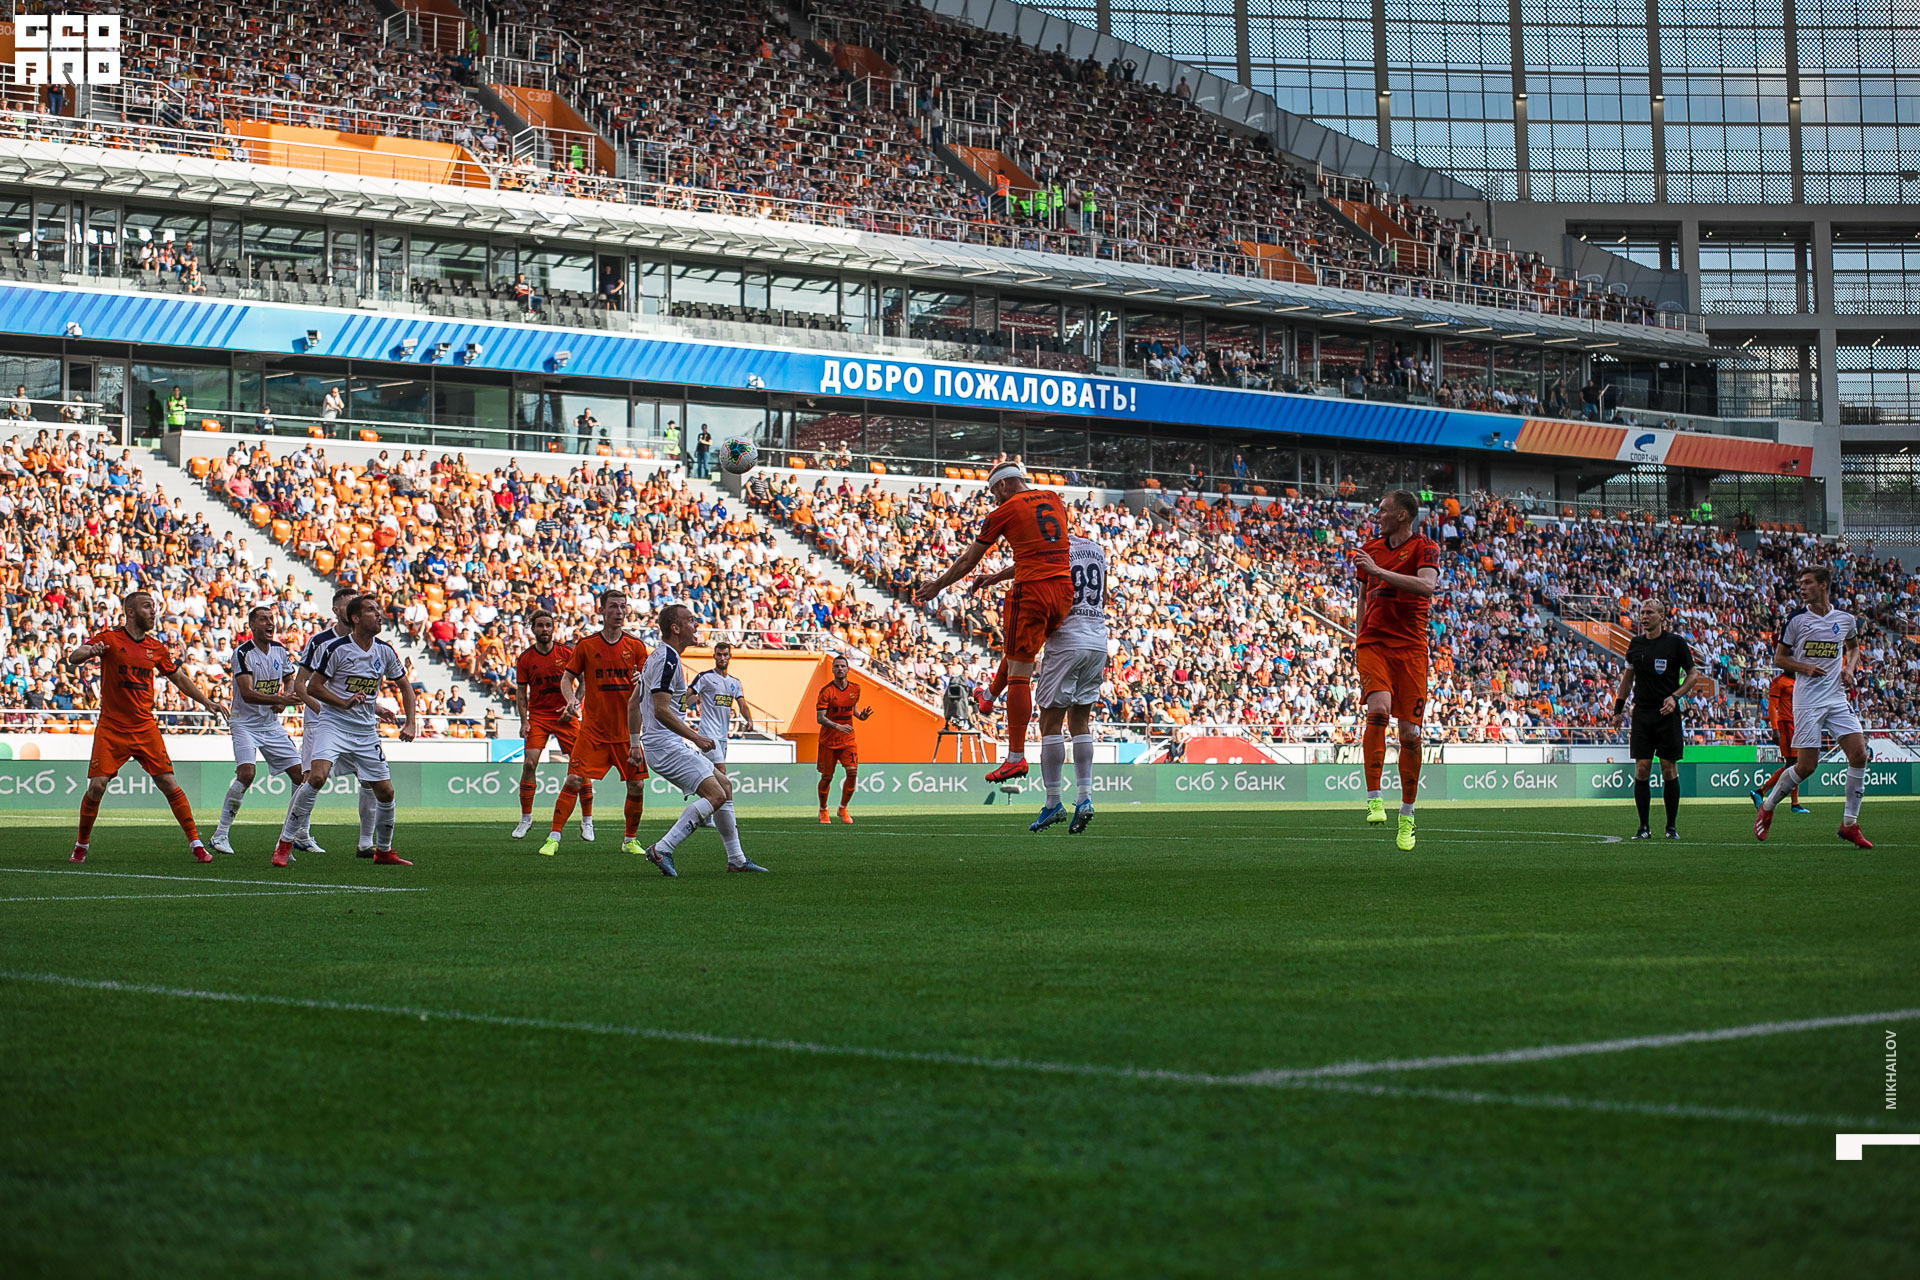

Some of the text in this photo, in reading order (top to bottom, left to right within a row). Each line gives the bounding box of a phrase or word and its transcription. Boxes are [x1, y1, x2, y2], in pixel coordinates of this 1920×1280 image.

[820, 360, 1137, 412] ДОБРО ПОЖАЛОВАТЬ!
[1036, 503, 1061, 543] 6
[1070, 563, 1102, 606] 99
[1805, 642, 1837, 650] ПАРИ
[1807, 649, 1838, 657] МАТЧ
[1413, 698, 1424, 718] 8
[0, 769, 56, 794] скб
[230, 774, 286, 794] кб
[448, 770, 501, 794] скб
[651, 770, 790, 794] ск банк
[908, 770, 968, 792] банк
[1092, 775, 1133, 791] анк
[1175, 771, 1286, 791] скб банк
[1325, 771, 1426, 790] скб бак
[1463, 770, 1558, 789] скб банк
[1591, 770, 1623, 788] скб
[1710, 769, 1741, 788] скб
[1821, 768, 1898, 786] скб банк
